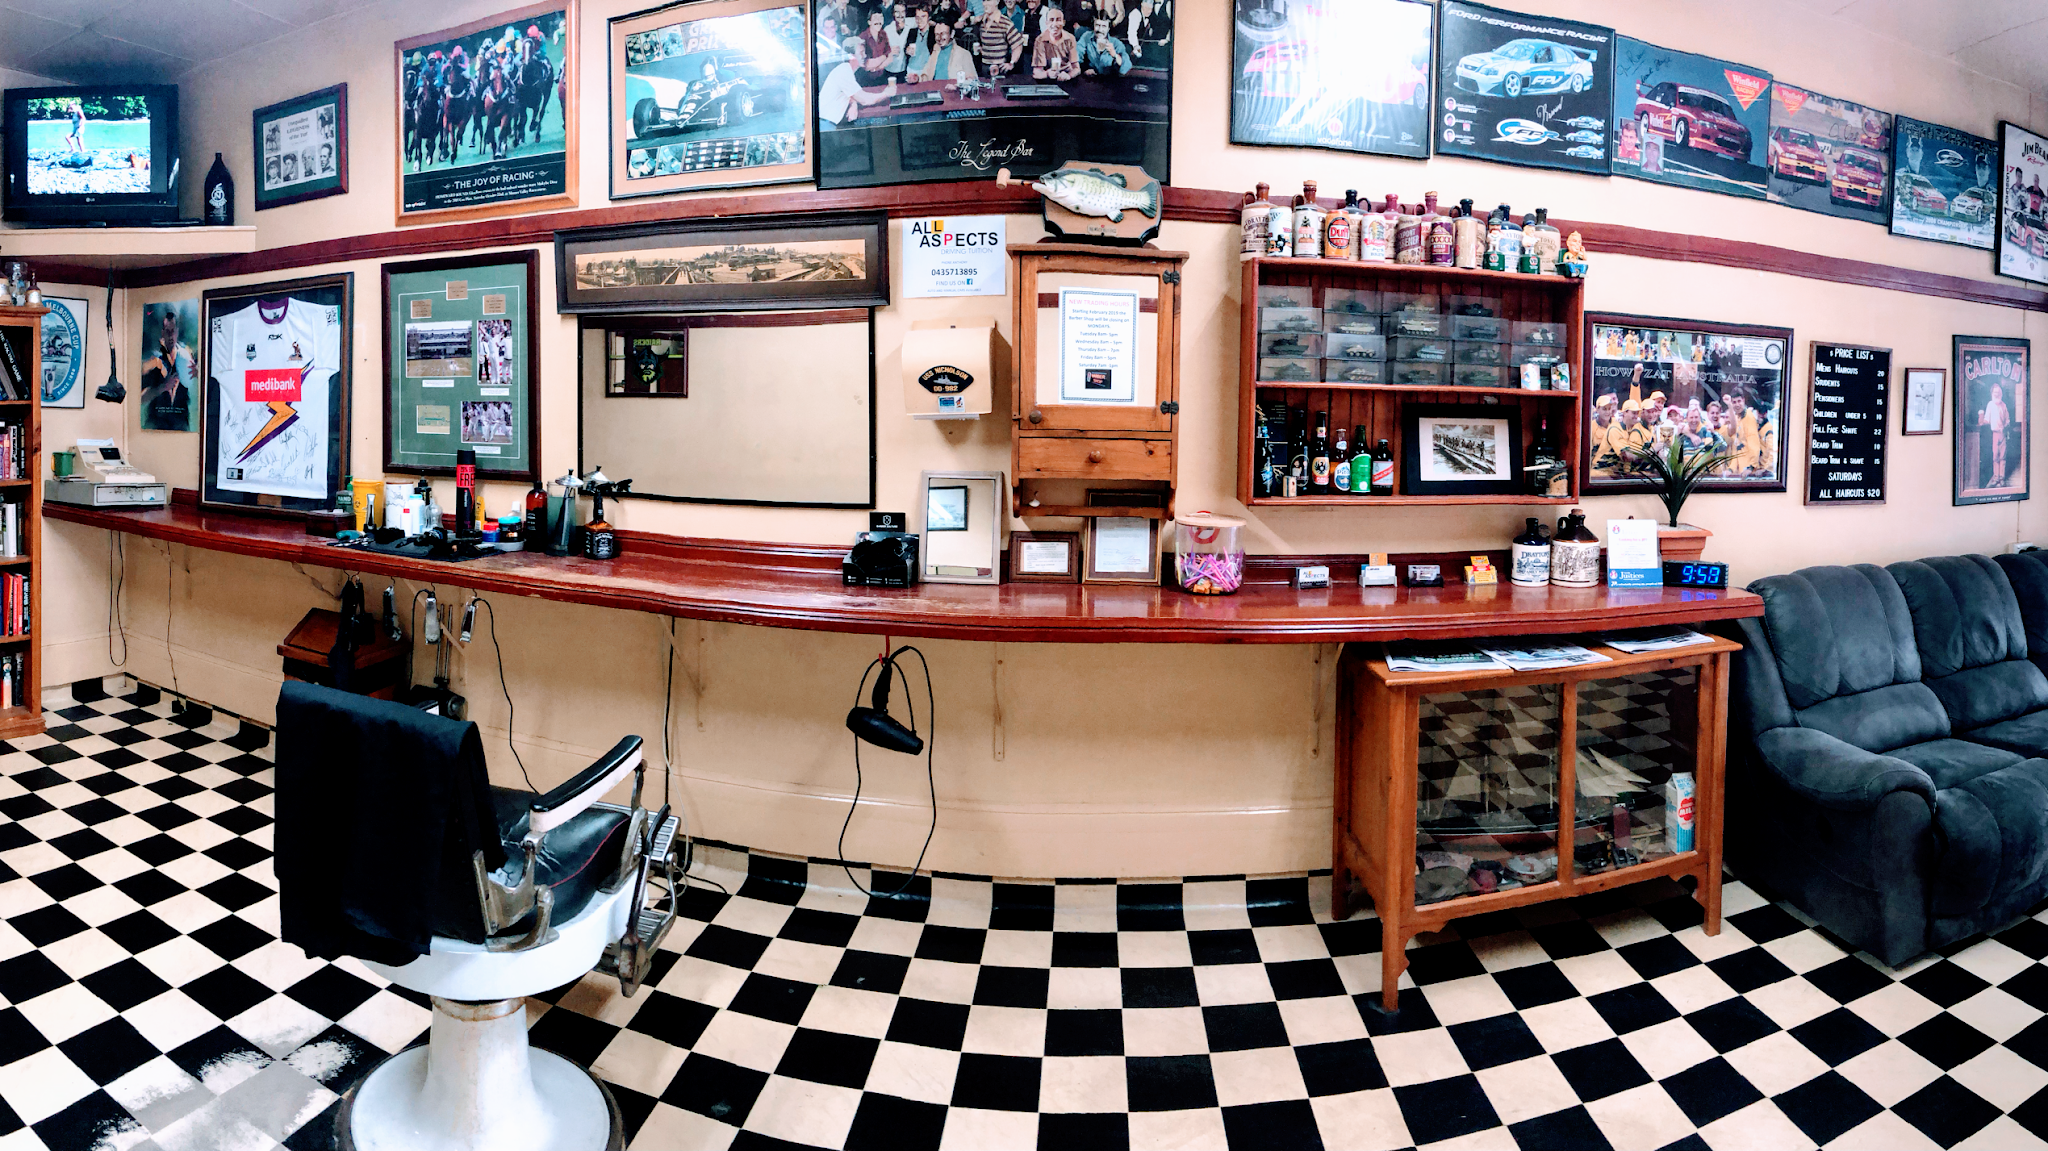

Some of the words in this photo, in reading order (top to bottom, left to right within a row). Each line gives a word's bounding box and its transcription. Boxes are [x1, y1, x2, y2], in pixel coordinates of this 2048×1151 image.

[1448, 9, 1481, 22] FORD
[1480, 16, 1567, 36] PERFORMANCE
[1566, 30, 1609, 43] RACING
[1531, 75, 1563, 85] FPV
[1732, 73, 1760, 89] Winfield
[1317, 137, 1353, 147] vodafone
[949, 141, 973, 159] The
[961, 138, 1008, 170] Legend
[1001, 139, 1034, 164] Bar
[2034, 142, 2048, 161] BEA
[2006, 164, 2015, 173] 17
[454, 180, 471, 190] THE
[472, 177, 489, 187] JOY
[489, 176, 501, 185] OF
[502, 170, 535, 183] RACING
[1894, 195, 1902, 210] 6
[1989, 213, 1996, 227] 5
[911, 220, 942, 235] ALL
[1330, 226, 1349, 237] Duff
[919, 232, 998, 248] ASPECTS
[931, 268, 978, 276] 0435713895
[45, 302, 76, 333] MELBOURNE
[71, 335, 79, 350] CUP
[1834, 348, 1854, 359] PRICE
[1855, 350, 1870, 360] LIST
[921, 370, 934, 381] USS
[934, 366, 969, 380] NICHOLSON
[1676, 371, 1758, 385] AUSTRALIA
[250, 377, 296, 391] medibank
[1873, 428, 1882, 436] 22
[1827, 471, 1863, 481] SATURDAYS
[1818, 488, 1833, 499] ALL
[1835, 488, 1865, 498] HAIRCUTS
[1866, 488, 1881, 498] $20
[1618, 571, 1635, 580] Justices
[1679, 806, 1693, 815] MIL
